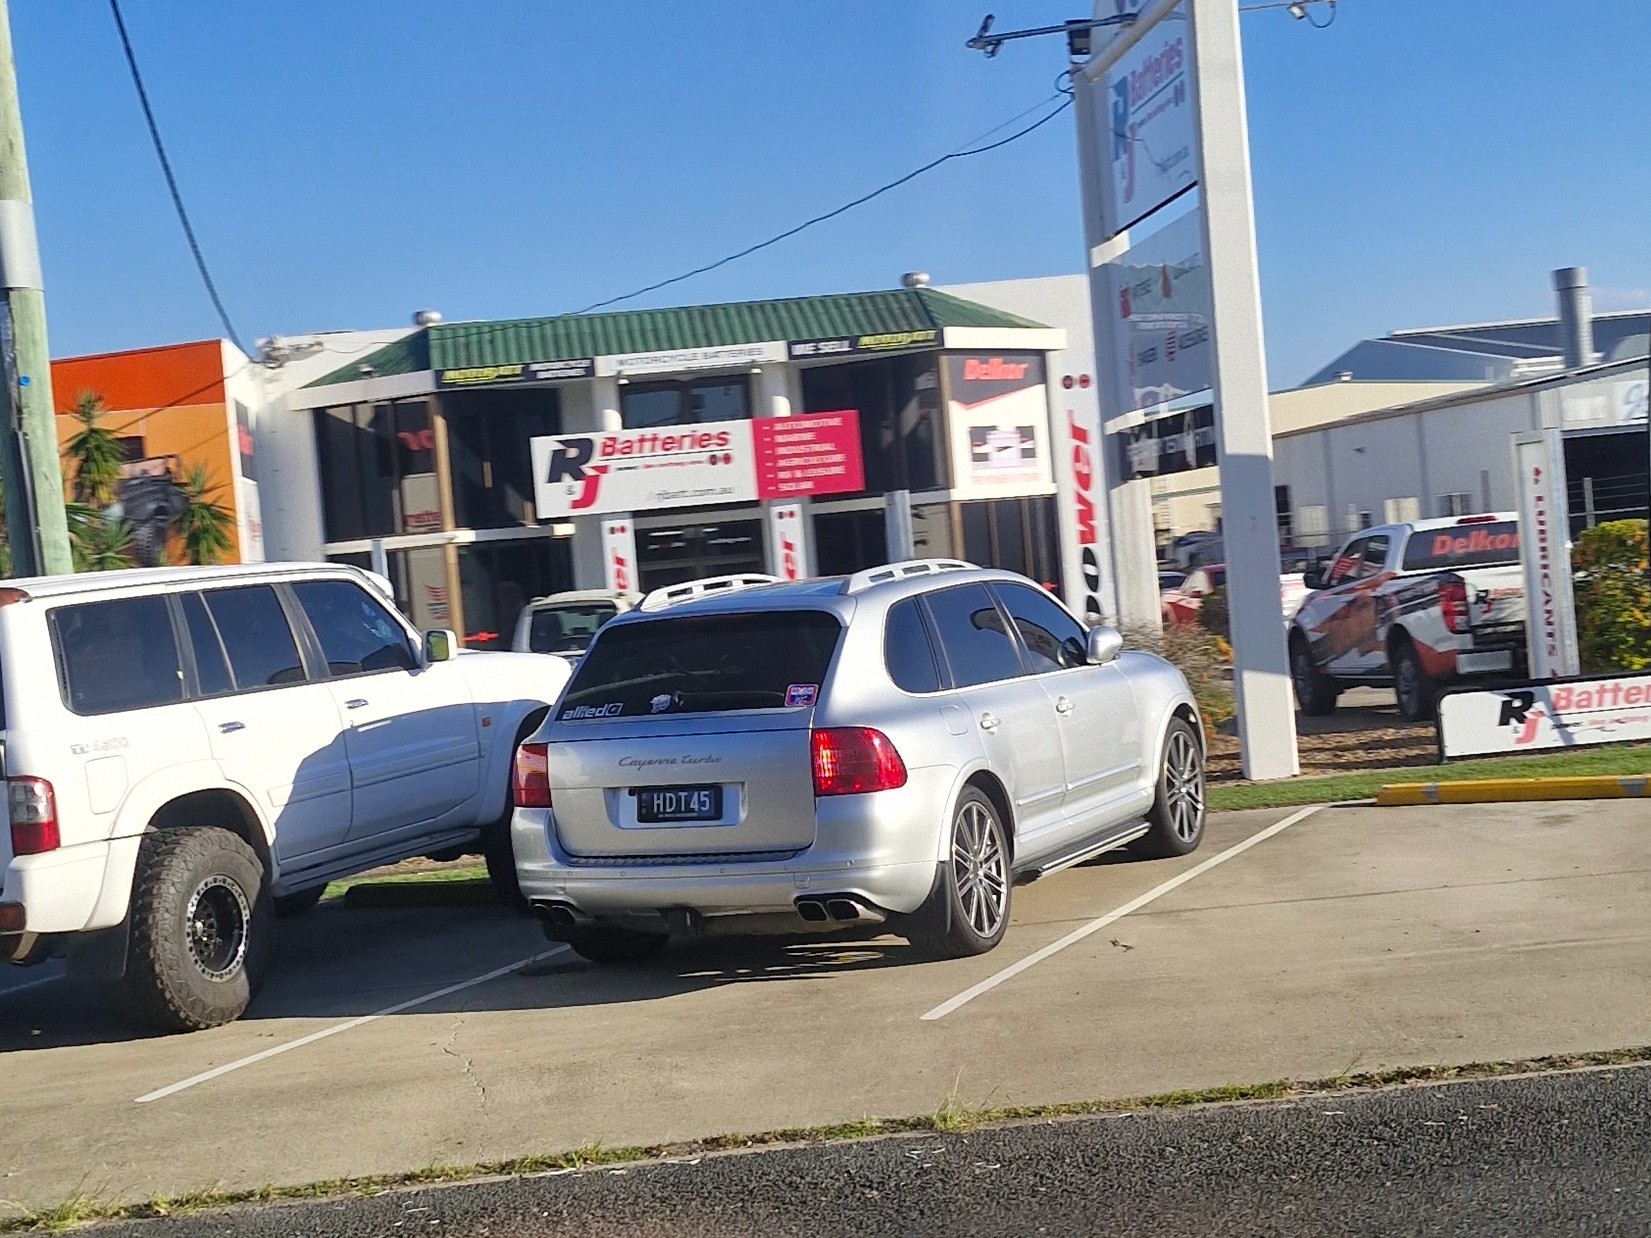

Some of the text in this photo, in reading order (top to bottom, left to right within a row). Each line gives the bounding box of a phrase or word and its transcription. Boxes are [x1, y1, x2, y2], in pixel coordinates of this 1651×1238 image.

[601, 430, 731, 457] Batteries
[545, 437, 594, 484] R
[1499, 690, 1535, 727] R
[619, 756, 677, 771] Cayenne
[653, 791, 710, 814] HDT45
